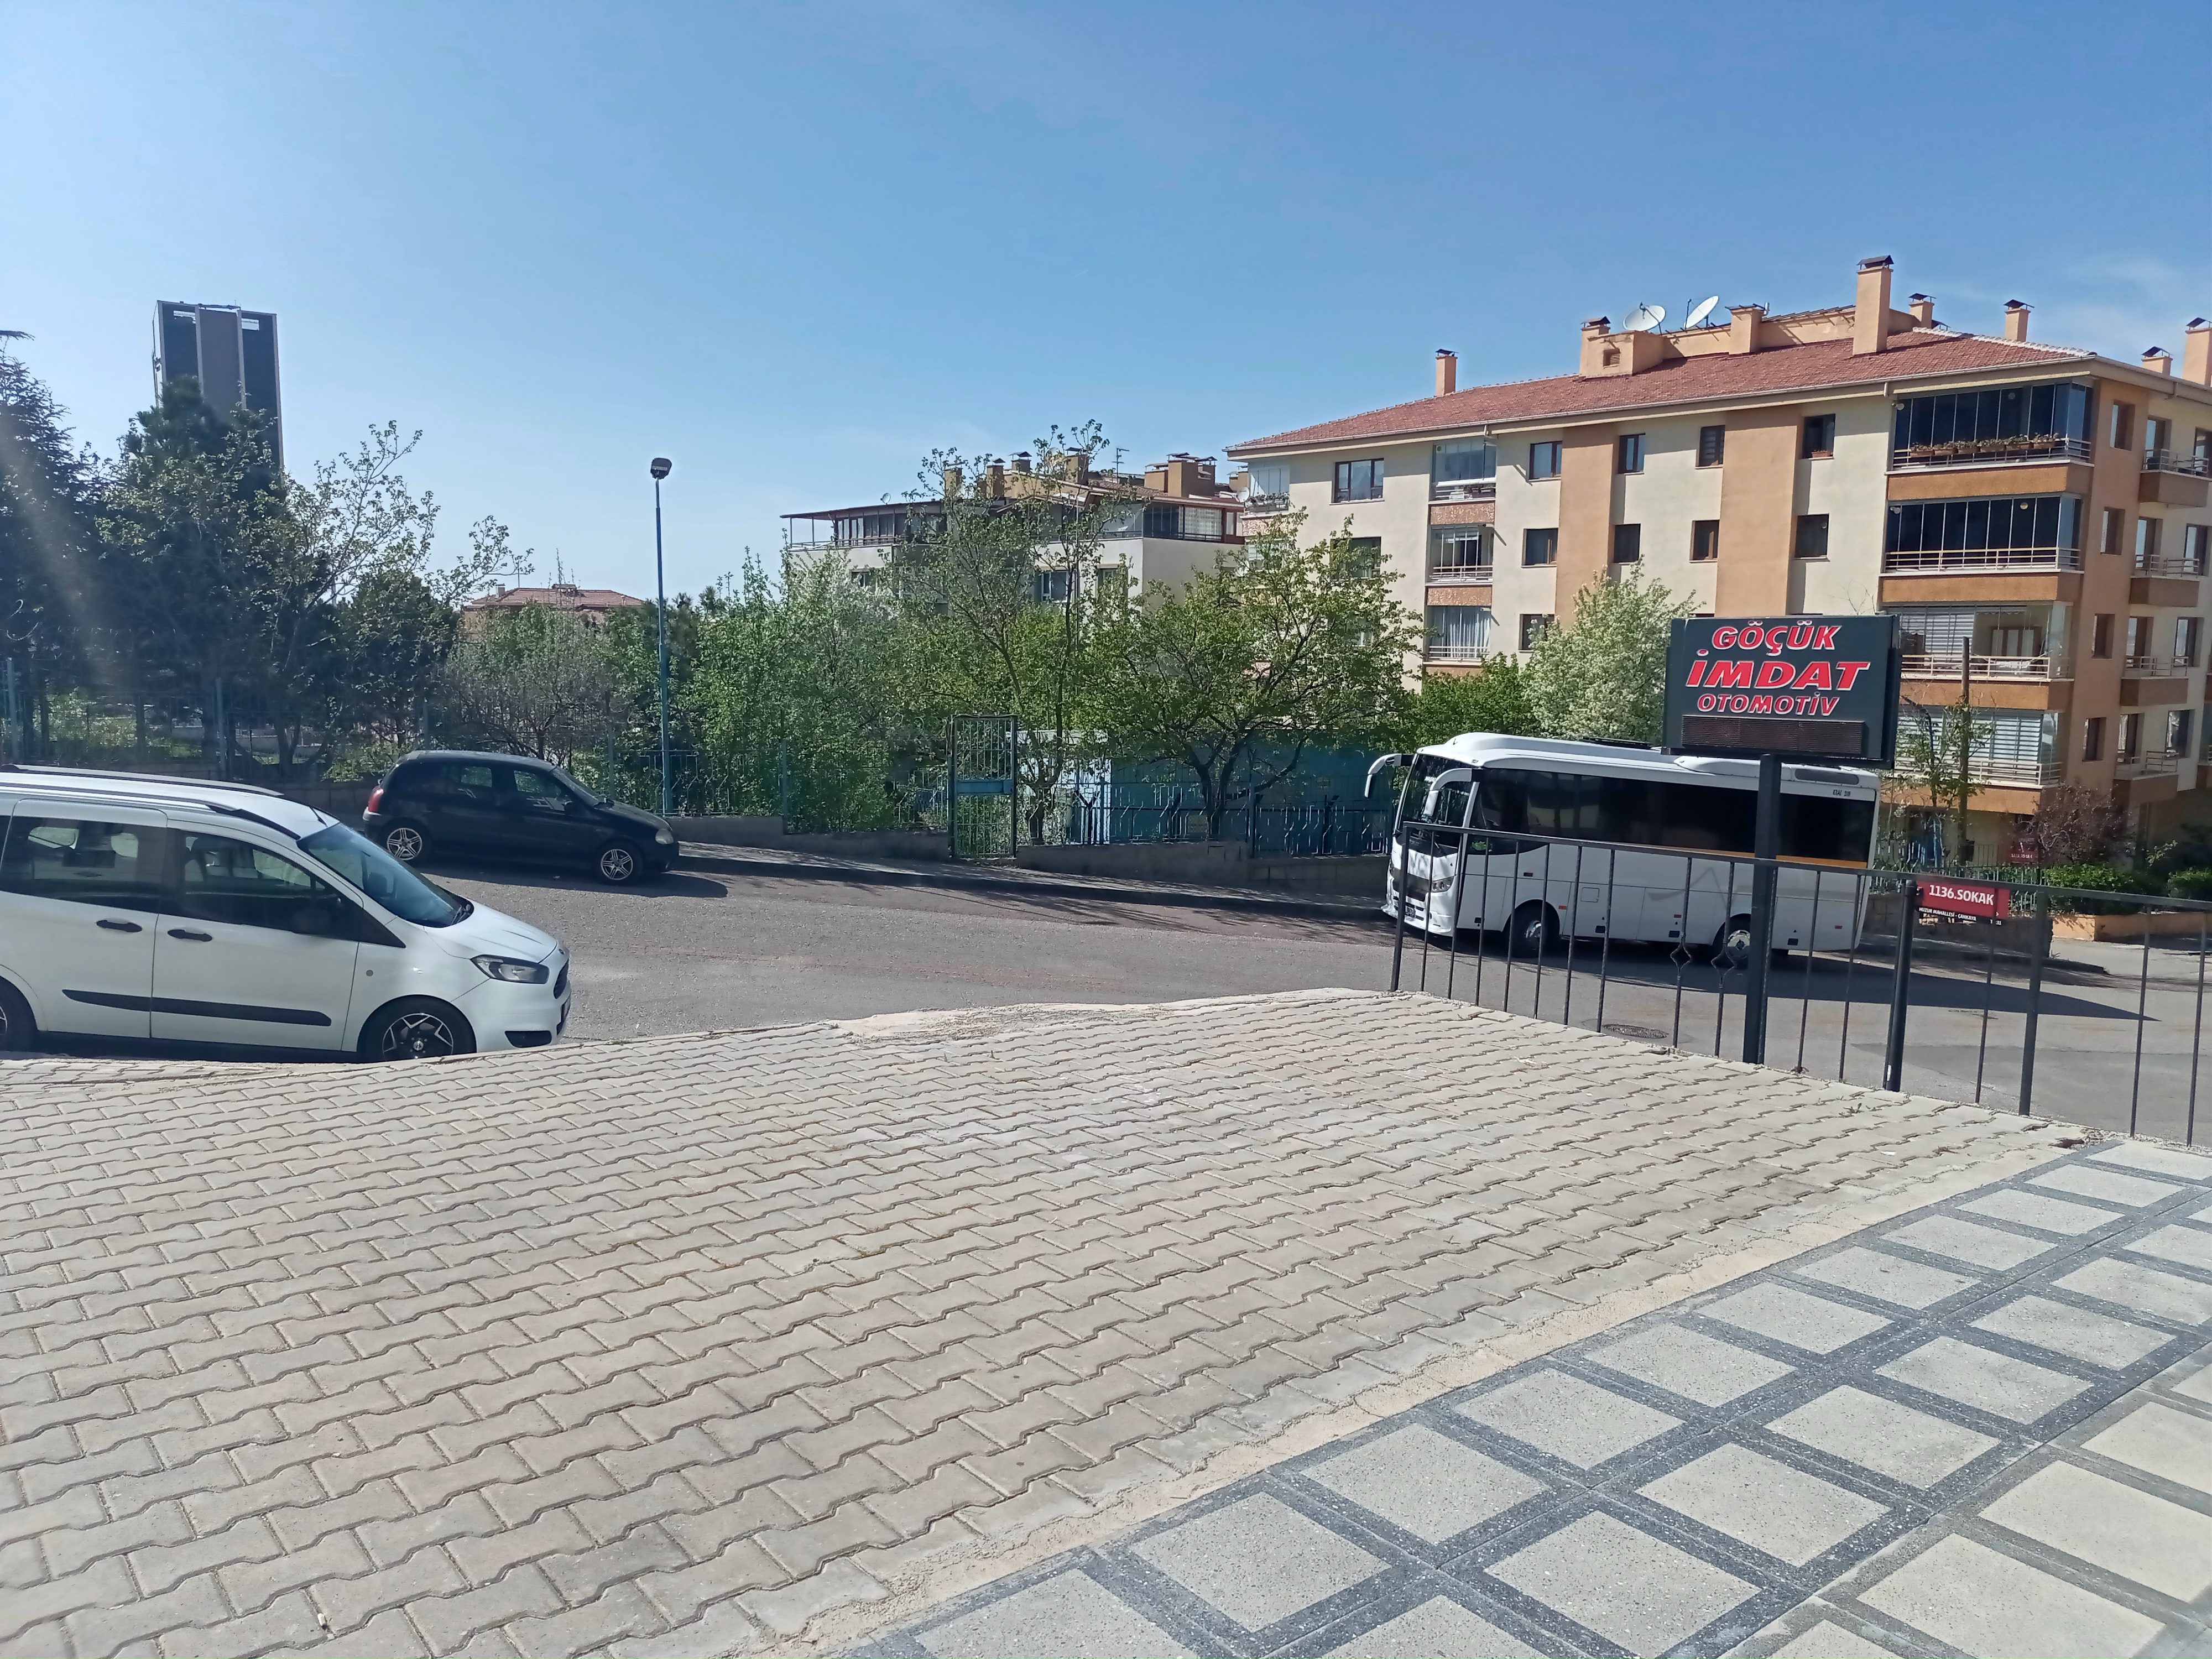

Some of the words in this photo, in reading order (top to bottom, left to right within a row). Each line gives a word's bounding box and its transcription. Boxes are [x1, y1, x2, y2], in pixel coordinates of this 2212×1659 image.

[1712, 620, 1842, 656] GÖÇÜK
[1686, 649, 1871, 691] İMDAT
[1697, 691, 1840, 716] OTOMOTİV
[1929, 884, 1994, 906] 1136.SOKAK
